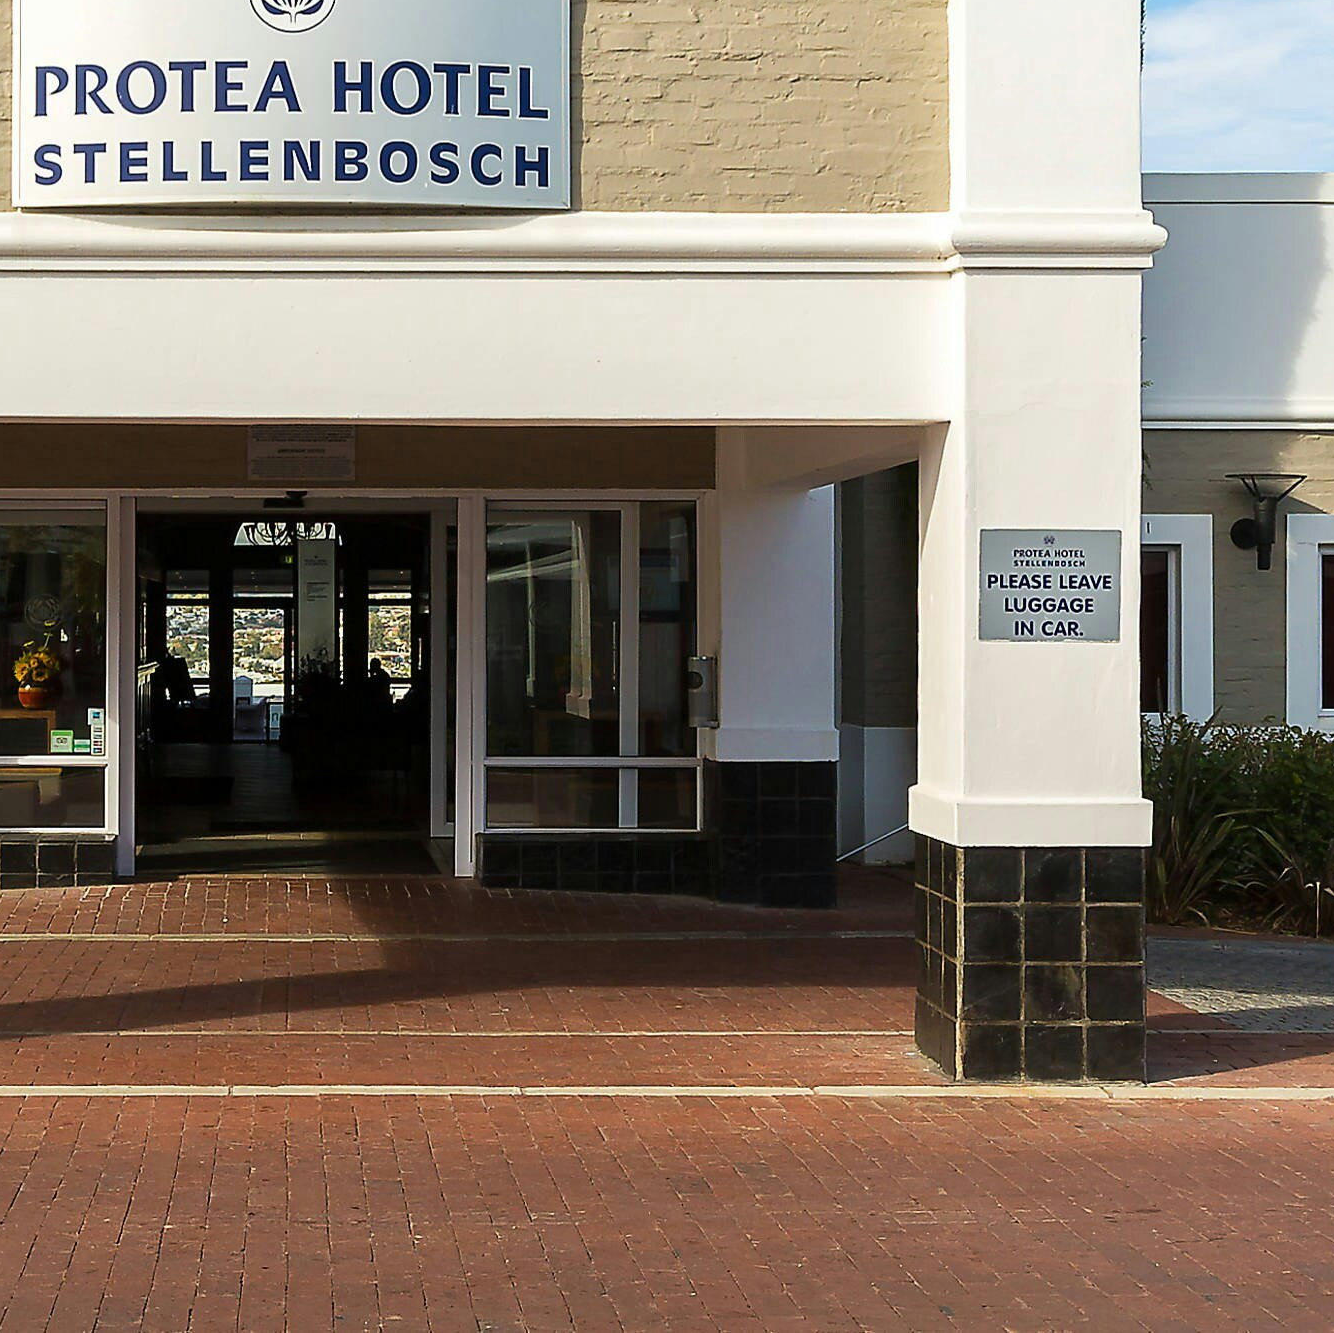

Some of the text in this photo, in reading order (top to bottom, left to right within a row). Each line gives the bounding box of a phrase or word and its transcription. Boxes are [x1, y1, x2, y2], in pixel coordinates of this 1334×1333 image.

[34, 60, 549, 119] PROTEA HOTEL
[34, 140, 549, 188] STELLENBOSCH
[1013, 550, 1085, 558] PROTEA HOTEL
[987, 574, 1112, 590] PLEASE LEAVE
[1004, 597, 1094, 613] LUGGAGE
[1014, 620, 1084, 636] IN CAR.
